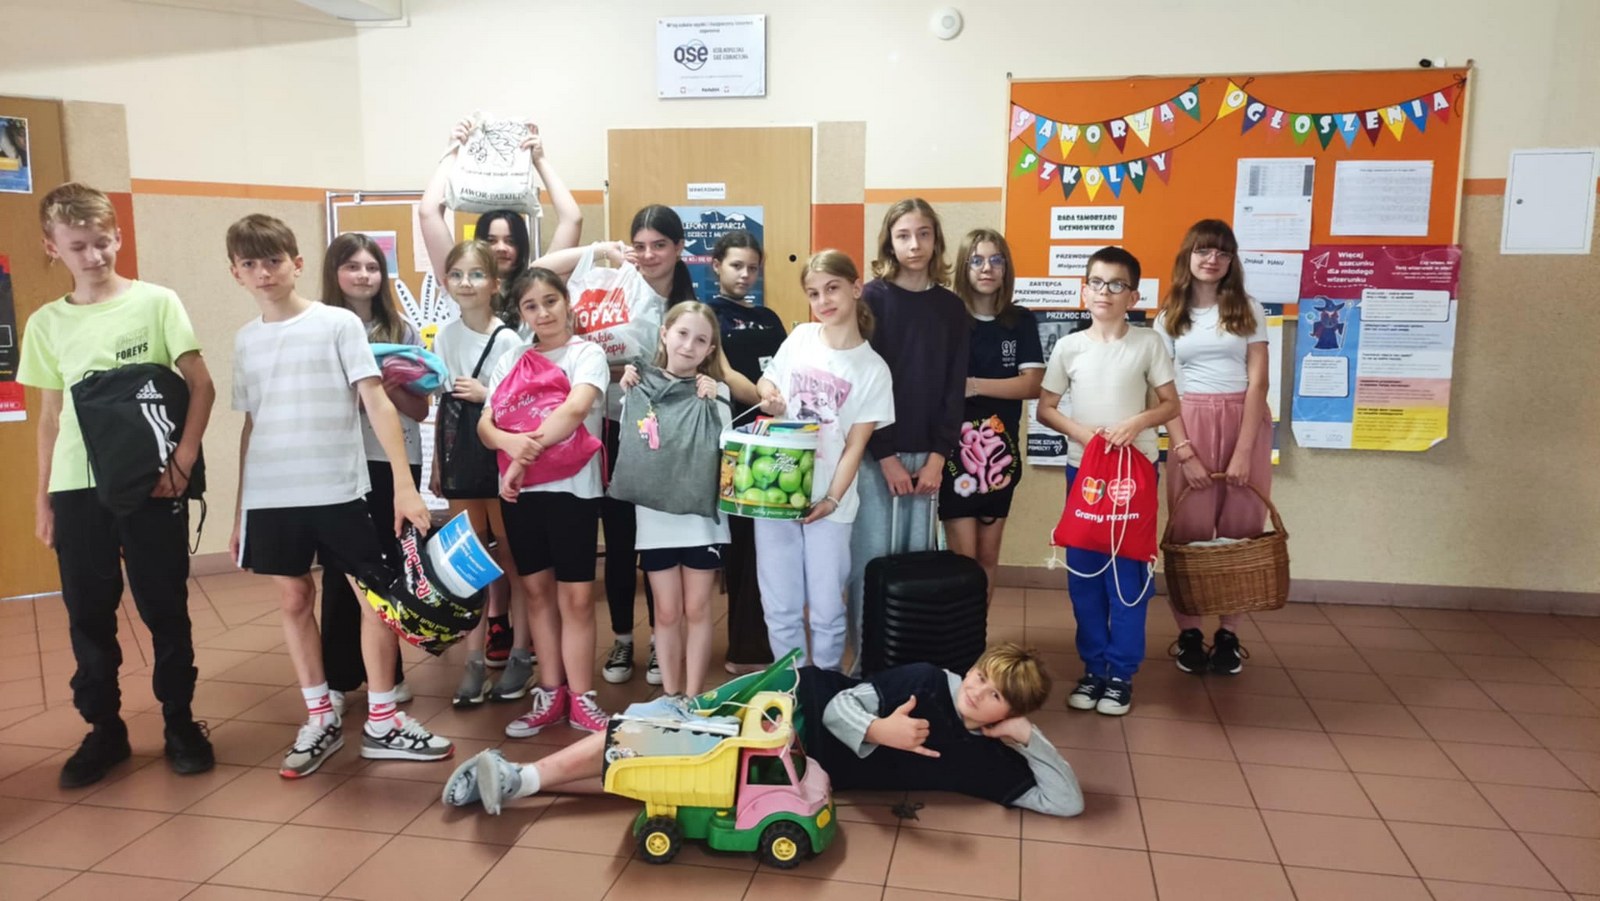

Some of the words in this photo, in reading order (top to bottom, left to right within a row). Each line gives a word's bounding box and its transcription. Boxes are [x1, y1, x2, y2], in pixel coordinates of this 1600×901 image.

[1227, 89, 1450, 134] OGŁOSZENIA
[1016, 91, 1198, 143] SAMORZĄD
[1020, 152, 1167, 186] SZKOLNY
[682, 222, 708, 230] LEFONY
[1338, 251, 1364, 260] Więcej
[1340, 268, 1374, 277] młodego
[1046, 311, 1080, 319] PRZEMOC
[136, 391, 163, 399] adidas
[1075, 508, 1104, 523] Gramy
[1106, 512, 1139, 521] razem
